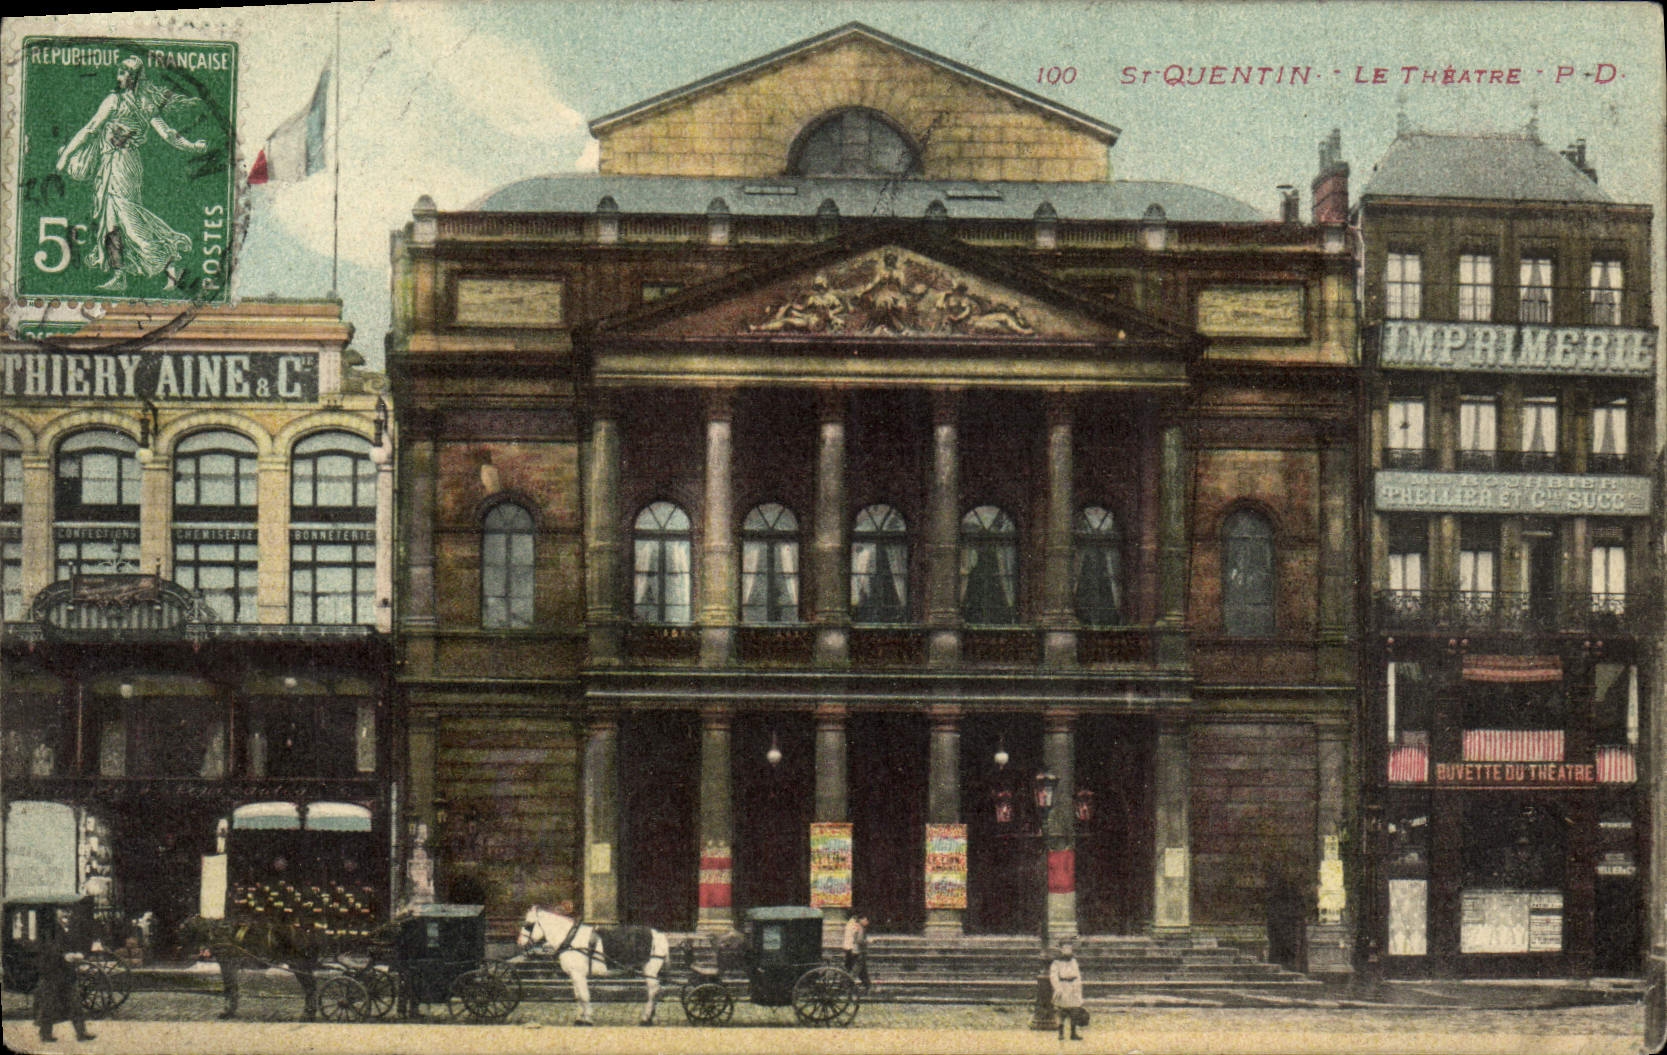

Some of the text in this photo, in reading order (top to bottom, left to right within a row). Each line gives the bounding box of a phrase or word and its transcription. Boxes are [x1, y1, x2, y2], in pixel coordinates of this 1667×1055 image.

[202, 204, 223, 291] POSTES
[1386, 320, 1652, 373] IMPRIMERIE
[1, 354, 142, 397] THIERY
[155, 354, 250, 397] AINE
[256, 377, 271, 397] &
[57, 528, 137, 540] CONFECTIONS
[176, 529, 254, 541] CHEMISERIE
[294, 529, 372, 541] BONNETERIE
[1436, 763, 1501, 781] BUVETTE
[1505, 764, 1525, 781] DU
